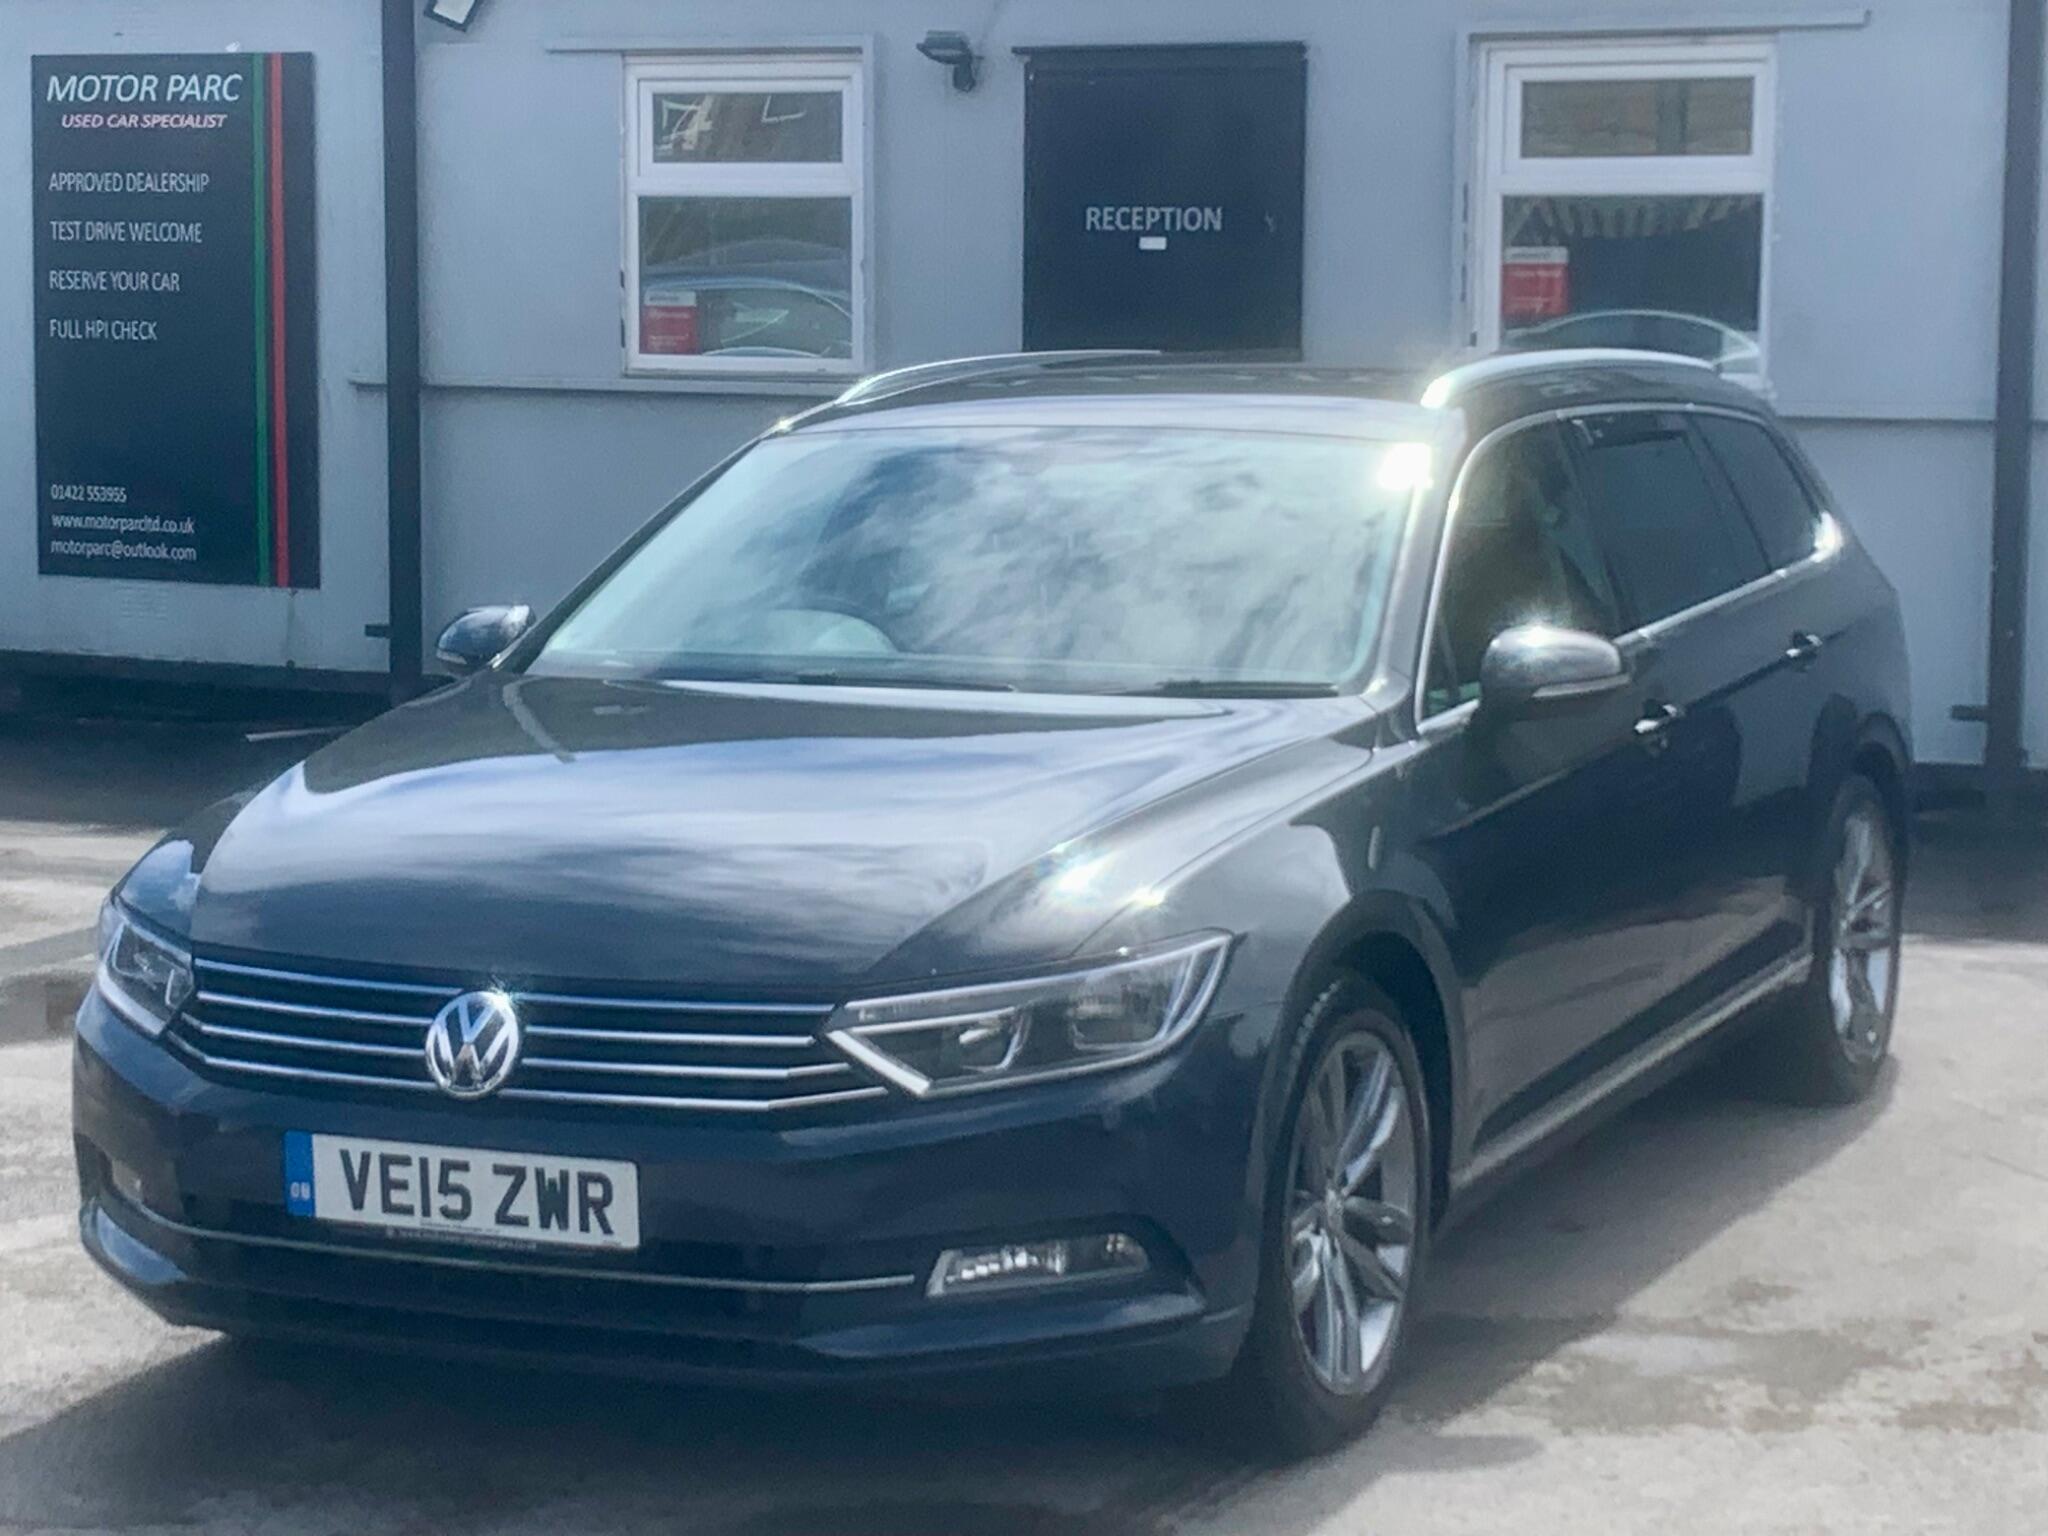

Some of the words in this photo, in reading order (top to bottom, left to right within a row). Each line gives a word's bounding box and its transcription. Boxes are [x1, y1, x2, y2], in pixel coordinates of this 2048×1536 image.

[47, 75, 158, 101] MOTOR
[166, 74, 243, 101] PARC
[61, 114, 103, 128] USED
[107, 114, 138, 128] CAR
[140, 114, 228, 128] SPECIALIST
[49, 173, 123, 192] APPROVED
[126, 173, 210, 193] DEALERSHIP
[1085, 206, 1223, 231] RECEPTION
[50, 221, 82, 241] TEST
[85, 221, 126, 242] DRIVE
[129, 222, 202, 243] WELCOME
[49, 270, 108, 291] RESERVE
[109, 271, 150, 292] YOUR
[151, 272, 180, 292] CAR
[49, 319, 82, 340] FULL
[85, 320, 109, 340] HPI
[111, 321, 158, 341] CHECK
[50, 484, 85, 501] 01422
[50, 539, 197, 561] motorparc@outlook.com
[492, 1162, 615, 1236] ZWR
